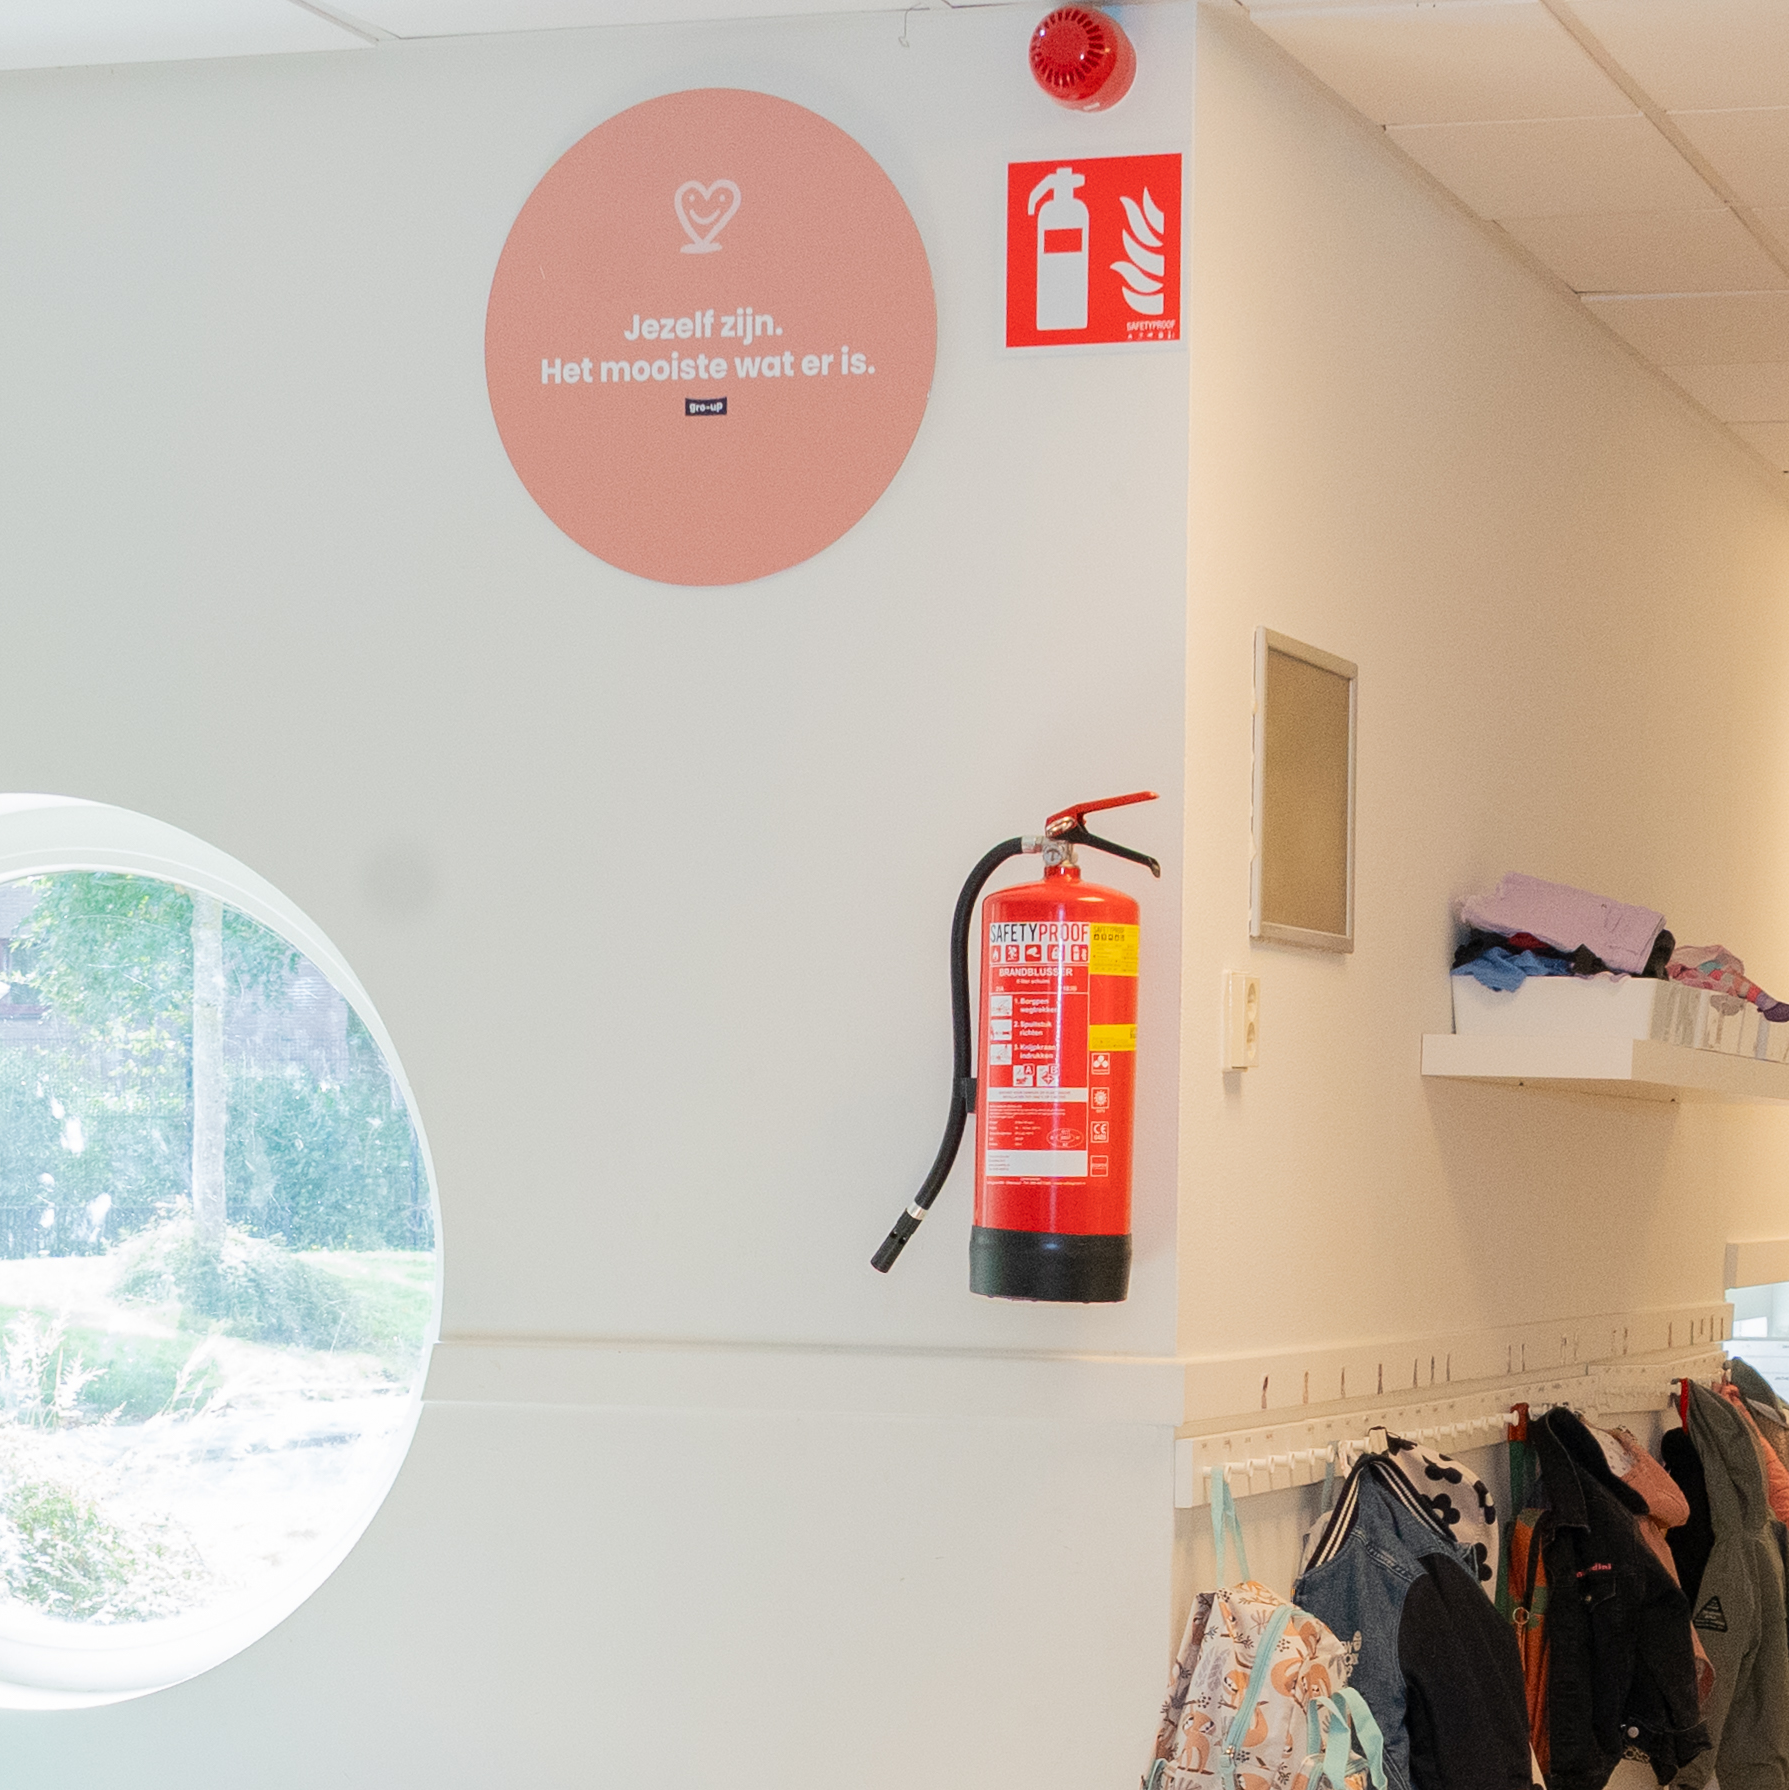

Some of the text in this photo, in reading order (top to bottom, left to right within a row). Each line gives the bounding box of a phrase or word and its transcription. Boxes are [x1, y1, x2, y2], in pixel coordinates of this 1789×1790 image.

[623, 306, 783, 346] Jezelf zijn.
[541, 345, 876, 384] Het mooiste wat er is.
[689, 401, 724, 414] gro-up
[990, 923, 1090, 943] SAFETYPROOF
[998, 967, 1074, 978] BRANDBLUSSER
[1025, 1066, 1033, 1074] A
